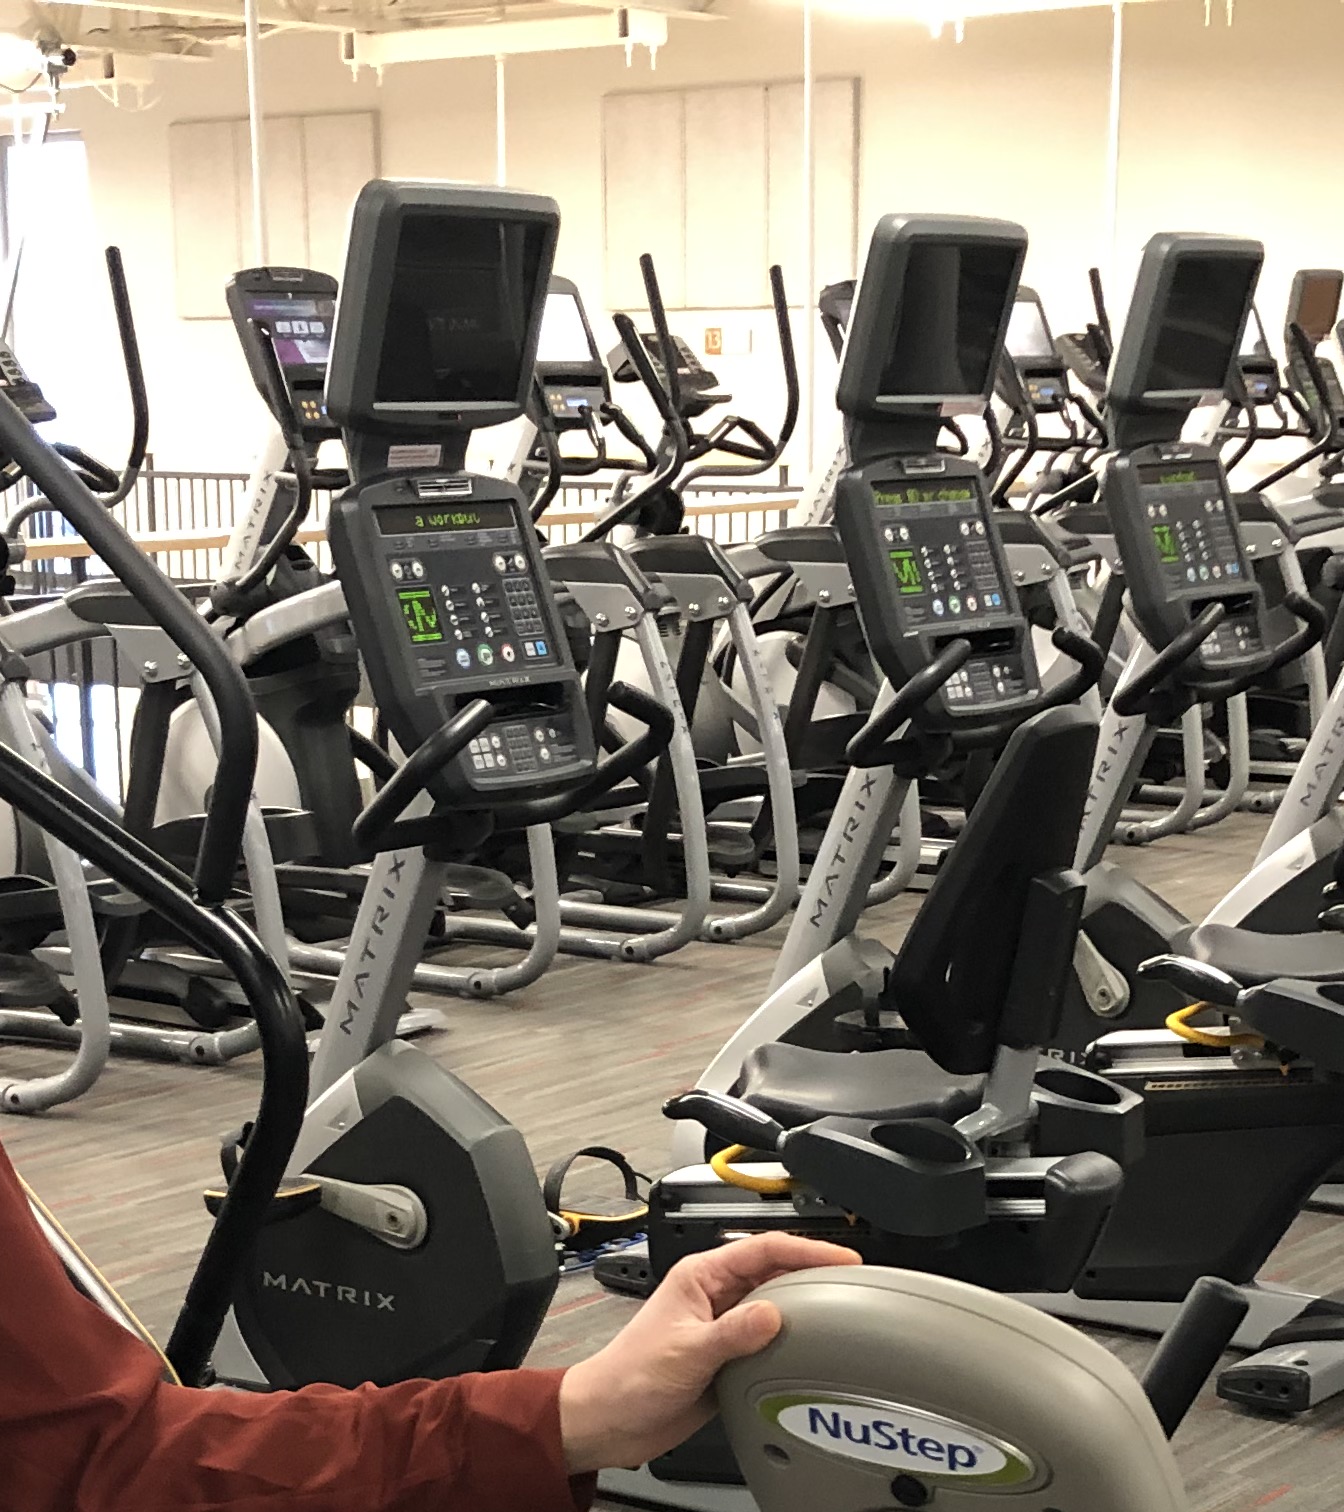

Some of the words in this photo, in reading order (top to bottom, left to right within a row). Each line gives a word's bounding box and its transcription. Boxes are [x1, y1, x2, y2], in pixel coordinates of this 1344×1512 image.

[809, 772, 877, 928] MATRIX
[340, 853, 406, 1035] MATRIX
[263, 1270, 396, 1312] MATRIX
[808, 1407, 977, 1471] NuStep
